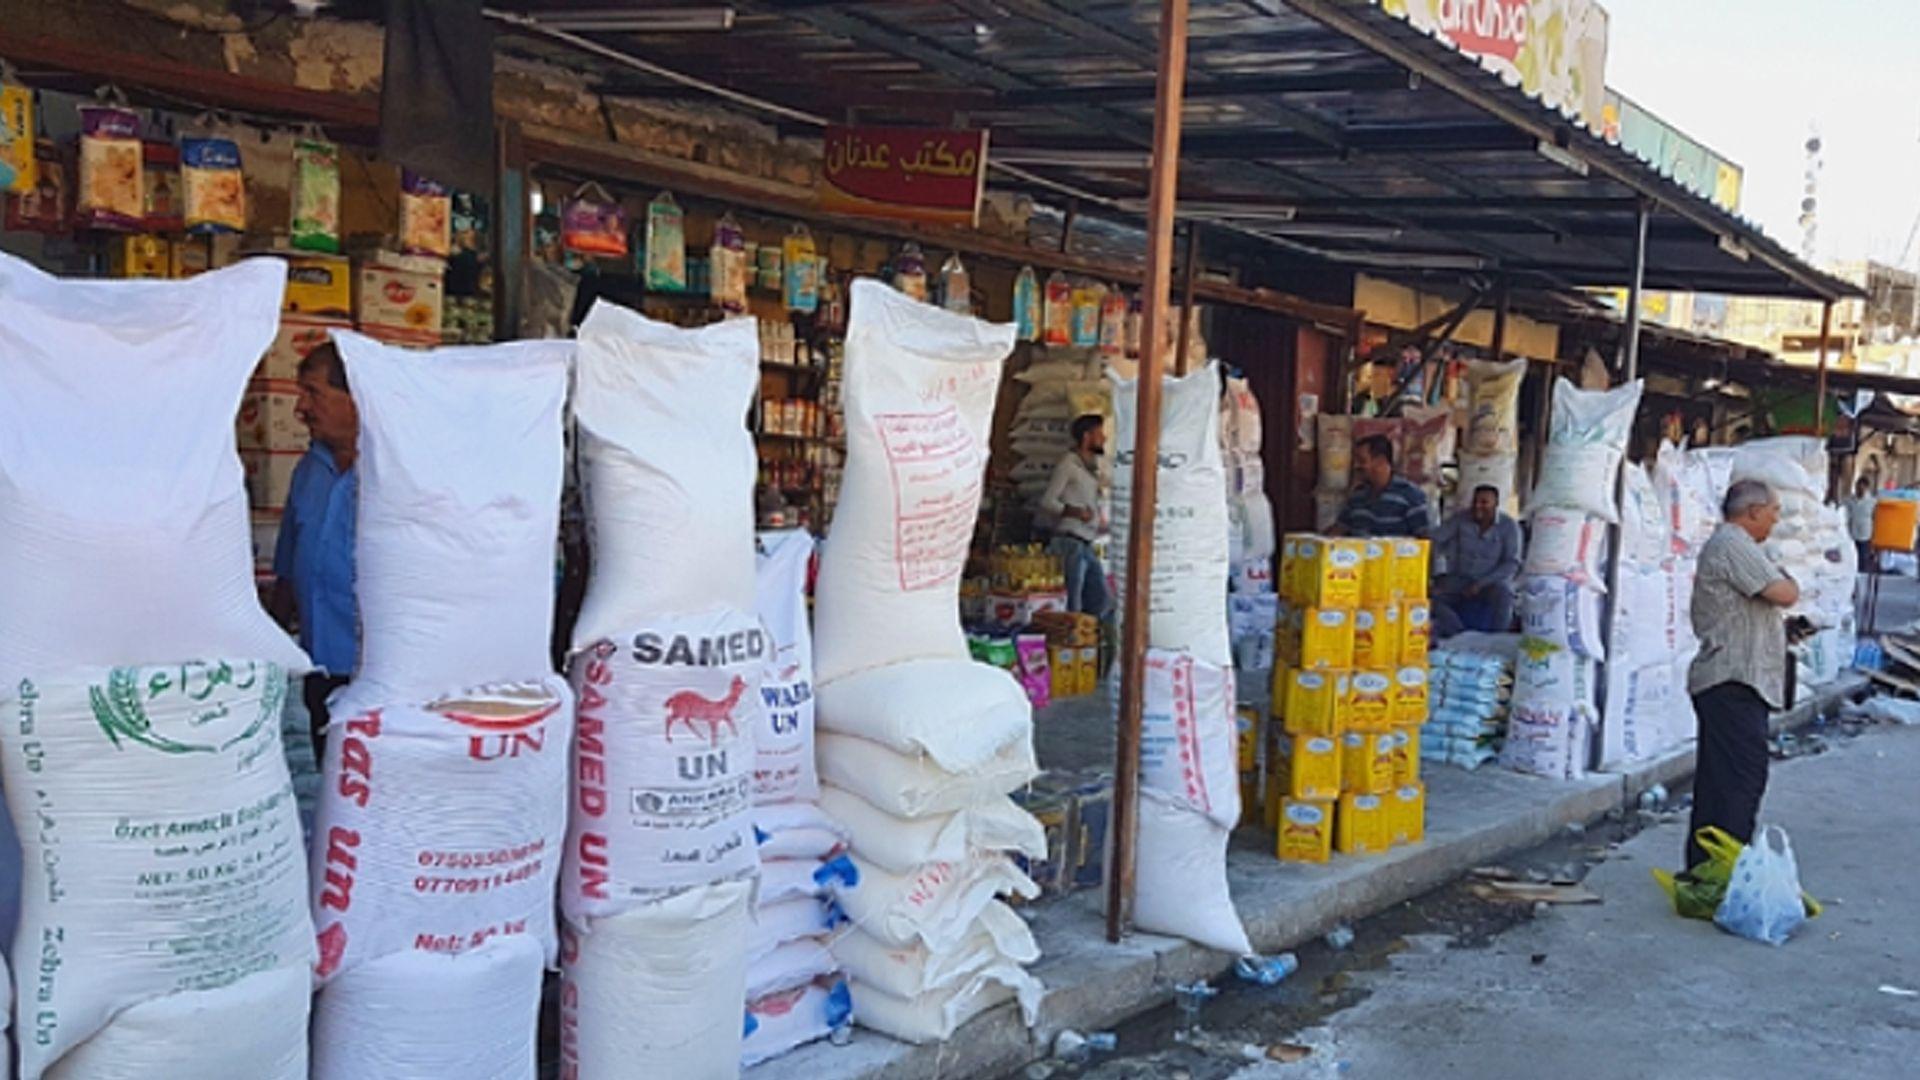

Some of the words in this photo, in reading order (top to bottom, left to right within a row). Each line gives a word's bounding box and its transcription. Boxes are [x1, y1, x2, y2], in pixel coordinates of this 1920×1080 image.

[826, 135, 891, 175] عدنان
[900, 140, 977, 182] مكتب
[632, 629, 764, 667] SAMED
[149, 661, 256, 700] زهراء
[577, 659, 613, 818] SAMED
[771, 711, 798, 734] UN
[467, 727, 545, 761] UN
[676, 751, 727, 780] UN
[319, 825, 362, 913] un
[579, 832, 609, 900] UN
[37, 926, 65, 1002] Zebra
[36, 1010, 58, 1046] Un
